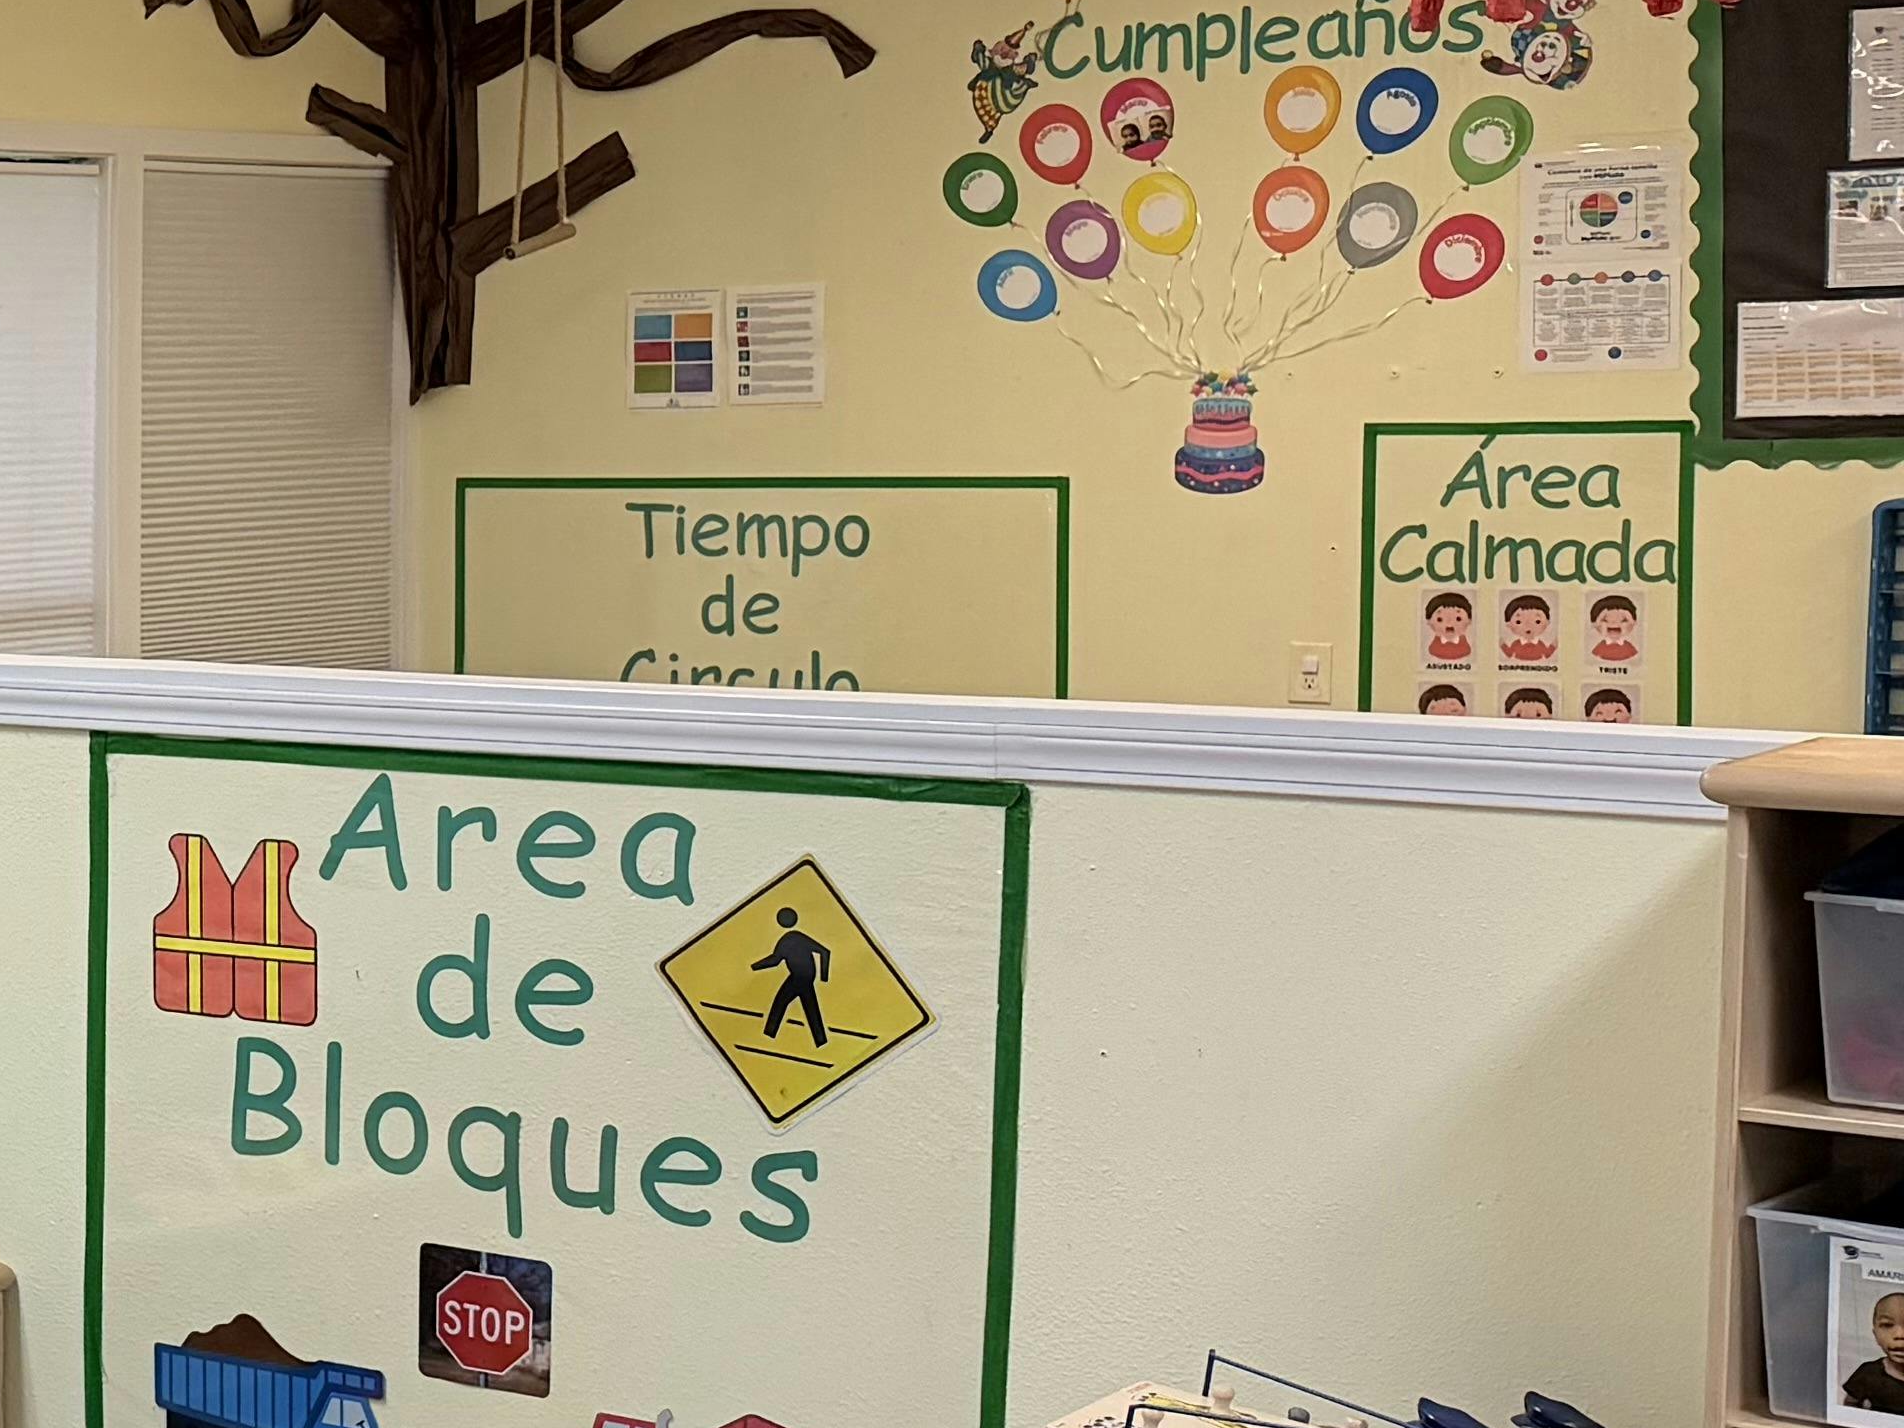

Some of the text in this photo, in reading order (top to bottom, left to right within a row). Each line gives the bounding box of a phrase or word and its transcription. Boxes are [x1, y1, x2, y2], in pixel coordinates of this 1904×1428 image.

[1440, 434, 1621, 509] Área
[625, 502, 871, 578] Tiempo
[1380, 518, 1677, 584] Calmada
[700, 574, 780, 637] de
[319, 771, 697, 907] Area
[414, 913, 597, 1048] de
[230, 1034, 819, 1244] Bloques
[443, 1299, 526, 1346] STOP
